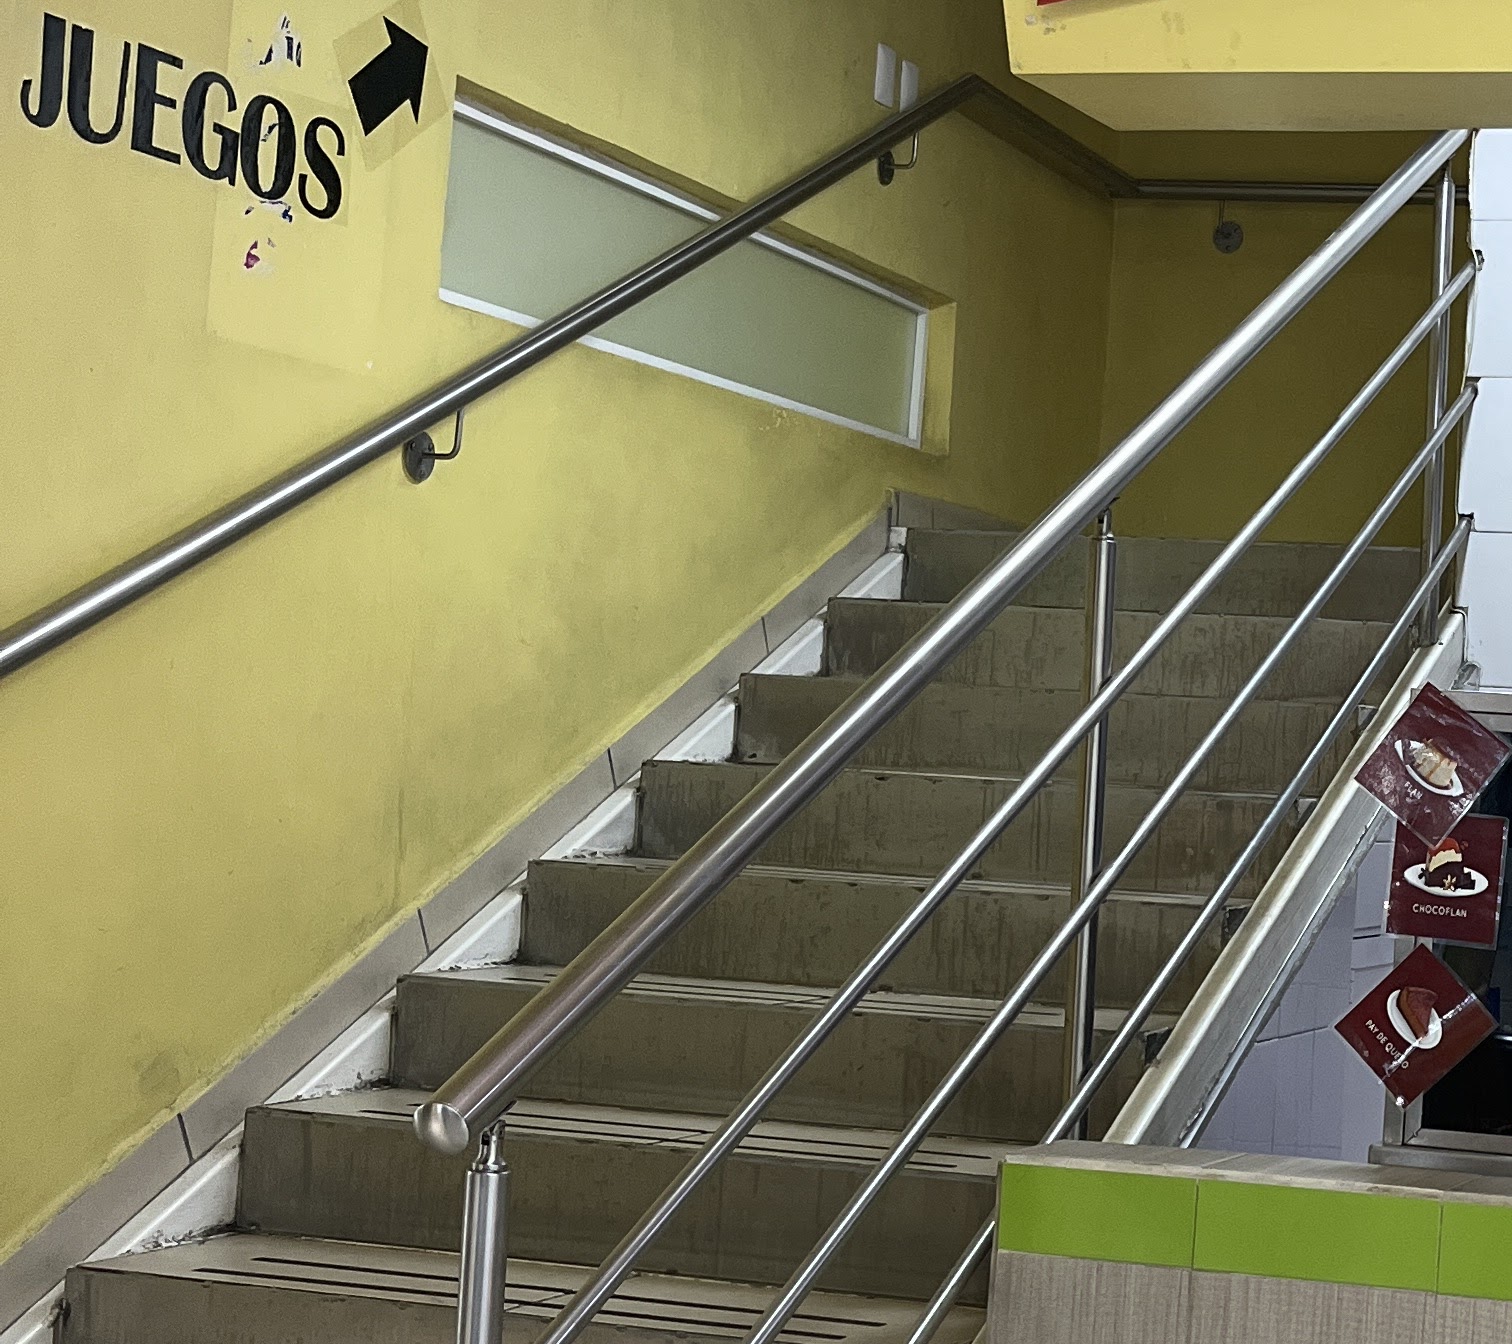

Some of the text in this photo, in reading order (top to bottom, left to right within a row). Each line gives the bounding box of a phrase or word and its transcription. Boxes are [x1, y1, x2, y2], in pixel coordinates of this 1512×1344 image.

[20, 11, 346, 220] JUEGOS
[1404, 781, 1423, 800] FLAN
[1411, 903, 1468, 918] CHOCOFLAN
[1365, 1019, 1410, 1069] PAY DE QUEO
